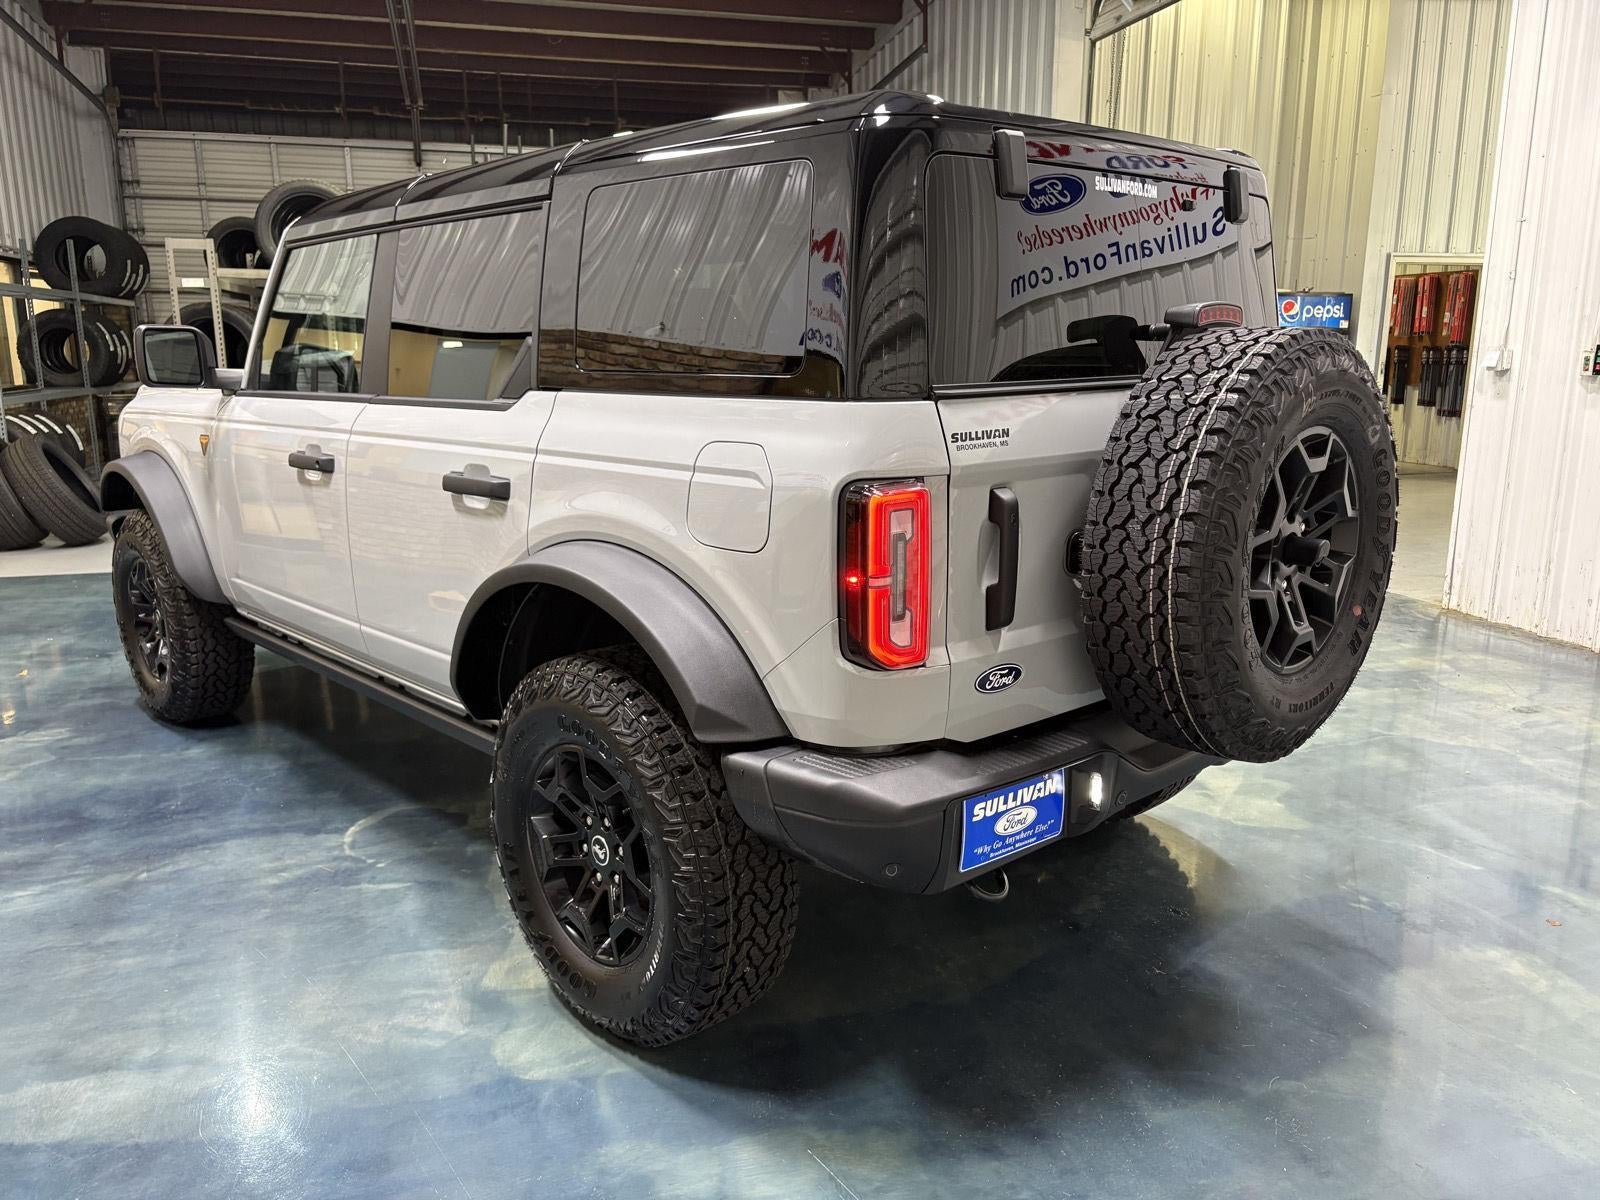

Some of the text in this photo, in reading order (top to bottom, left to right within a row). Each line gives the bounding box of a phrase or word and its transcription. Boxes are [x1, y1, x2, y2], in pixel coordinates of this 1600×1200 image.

[1095, 176, 1158, 199] SULLIVANFORD.COM
[1303, 302, 1344, 321] pepsi
[951, 428, 1010, 443] SULLIVAN
[956, 441, 999, 451] BROOKHAVEN,
[985, 669, 1016, 690] Ford
[972, 777, 1058, 822] SULLIVAN
[1003, 811, 1029, 832] Ford
[993, 840, 1003, 850] Go
[1004, 828, 1034, 846] Anywhere
